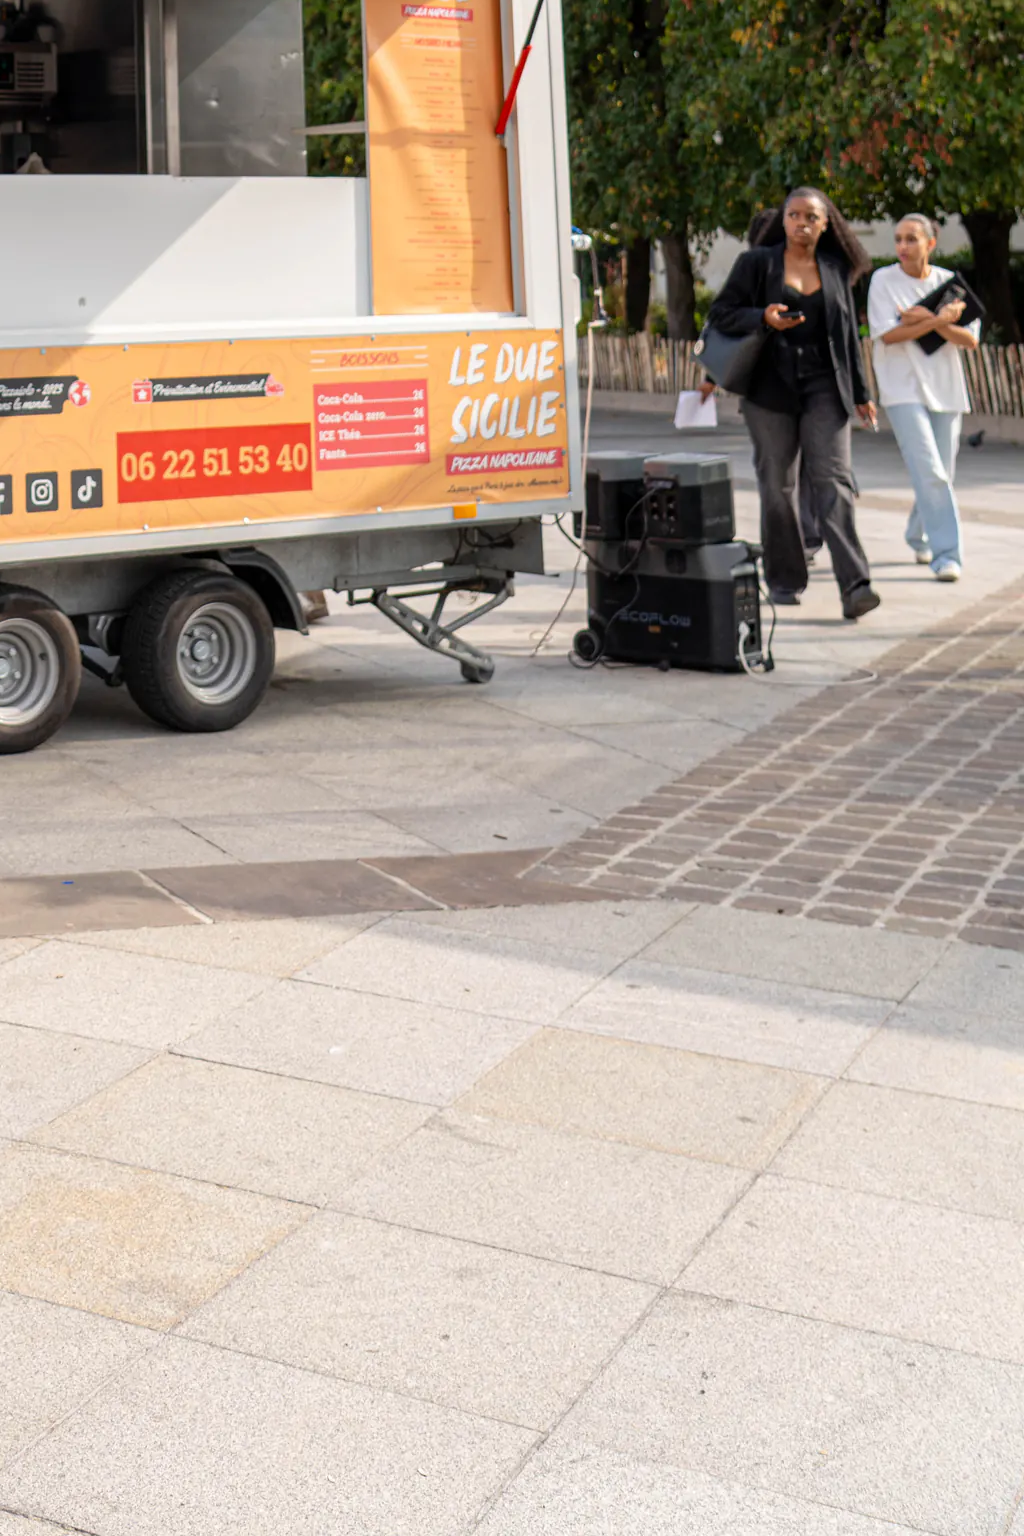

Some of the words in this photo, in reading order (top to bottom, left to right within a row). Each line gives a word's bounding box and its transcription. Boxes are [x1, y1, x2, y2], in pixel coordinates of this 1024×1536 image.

[340, 352, 399, 367] BOISSONS
[448, 343, 488, 386] LE
[493, 340, 558, 383] DUE
[317, 392, 363, 406] Coca-Cola
[318, 410, 363, 424] Coca-Cola
[450, 390, 560, 443] SICILIE
[319, 431, 335, 442] ICE
[319, 448, 347, 460] Fanta
[450, 455, 488, 473] PIZZA
[490, 450, 557, 468] NAPOLITAINE
[121, 451, 156, 482] 06
[162, 449, 196, 479] 22
[203, 447, 232, 477] 51
[238, 445, 270, 474] 53
[276, 442, 308, 472] 40
